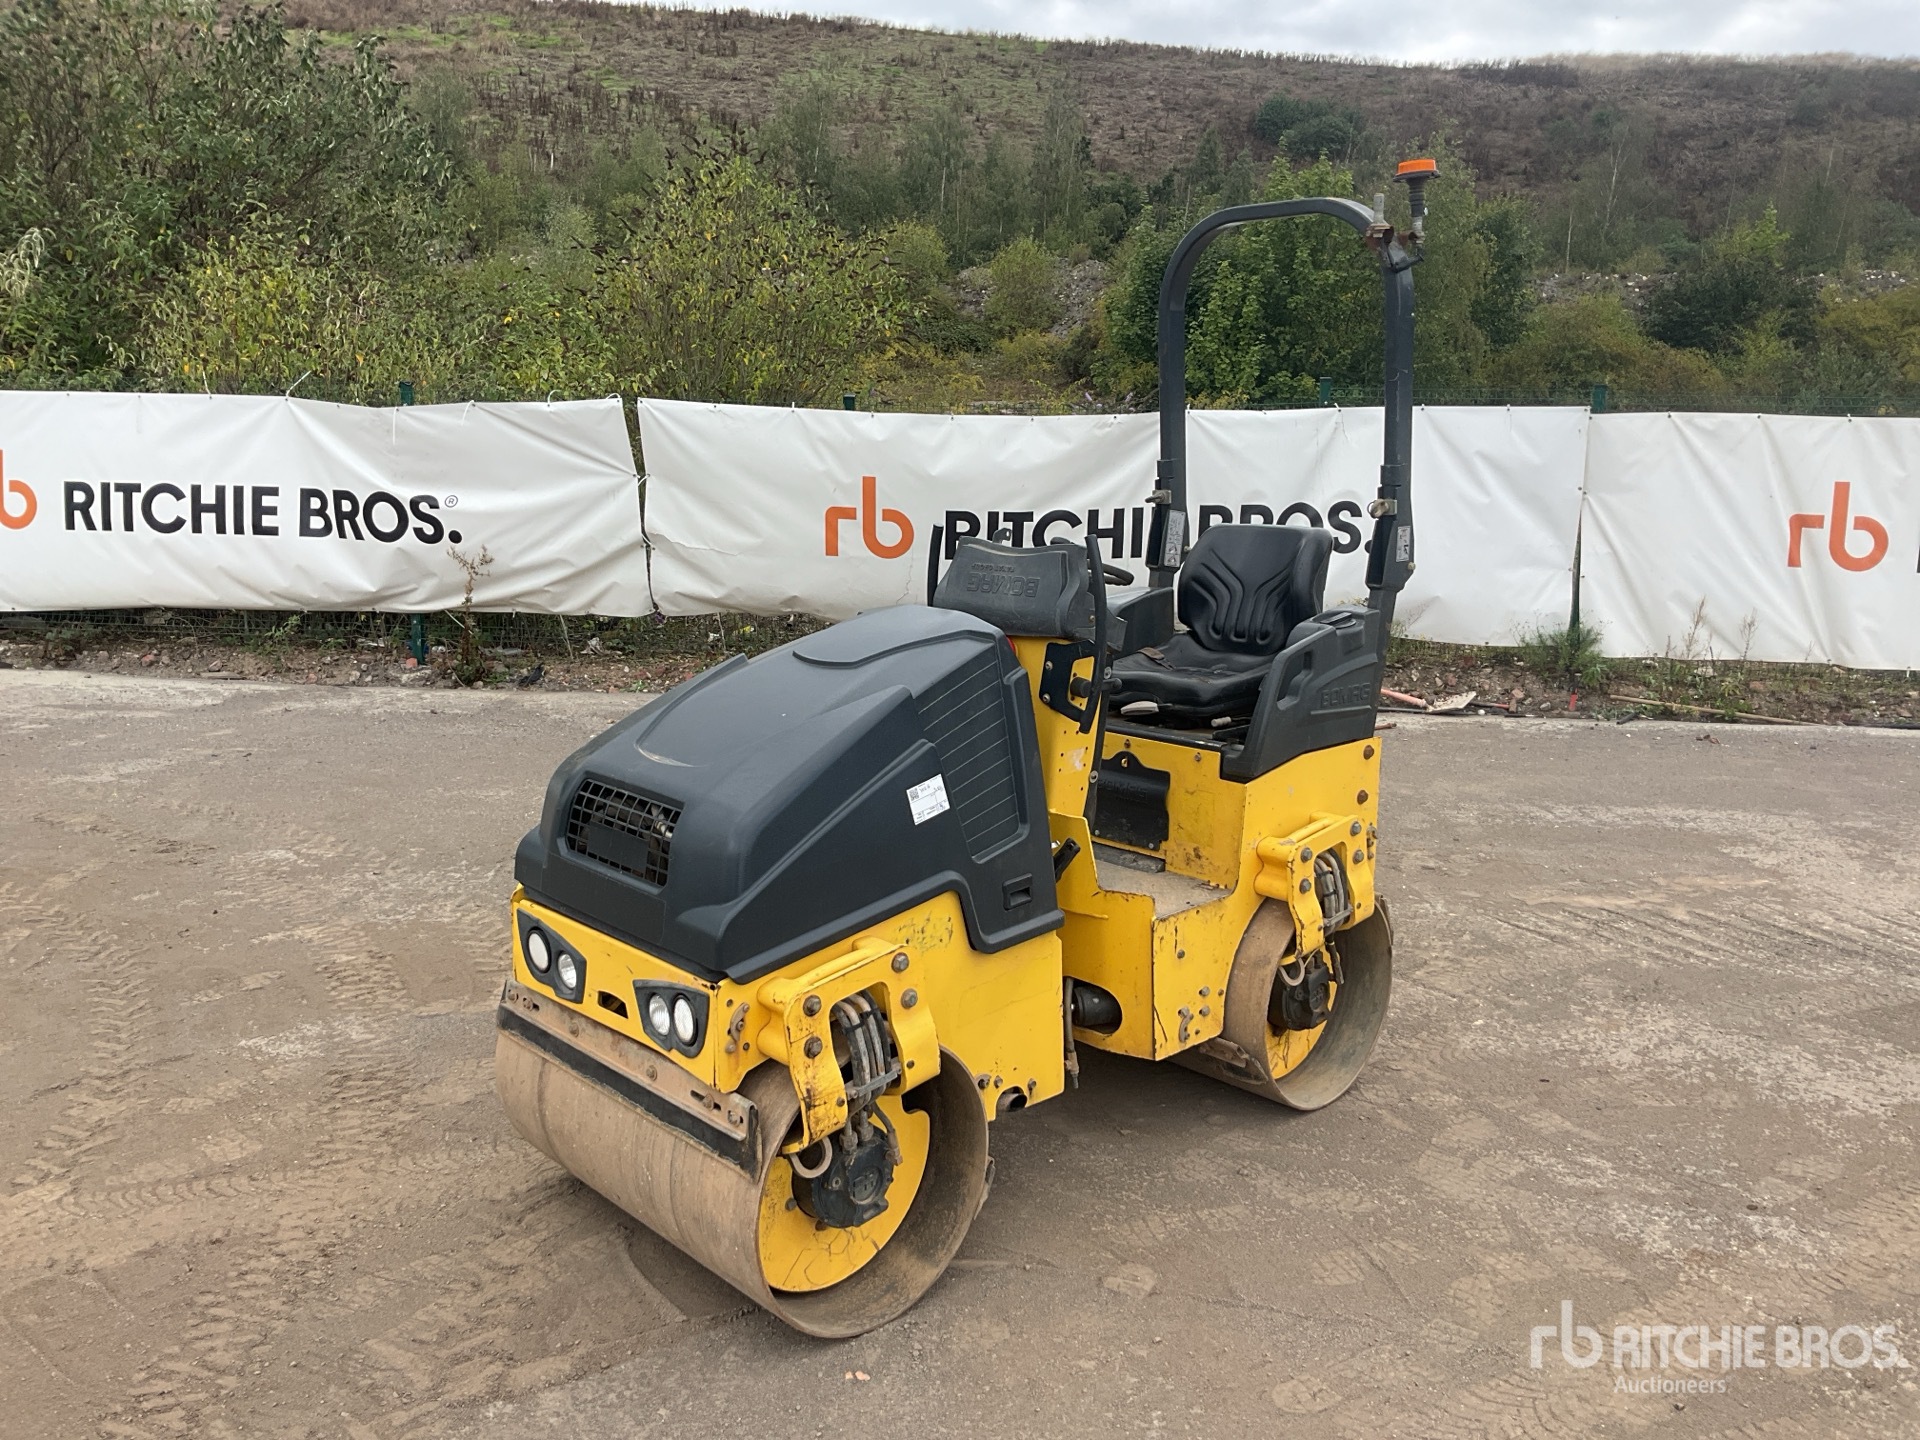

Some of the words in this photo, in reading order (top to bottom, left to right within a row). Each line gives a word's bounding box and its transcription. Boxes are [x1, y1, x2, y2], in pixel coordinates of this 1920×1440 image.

[63, 481, 279, 537] RITCHIE
[825, 476, 914, 559] rb
[945, 507, 1155, 560] RITCHI
[1787, 481, 1889, 572] rb
[966, 572, 1041, 597] BOMAG
[1320, 682, 1371, 708] BOMAG
